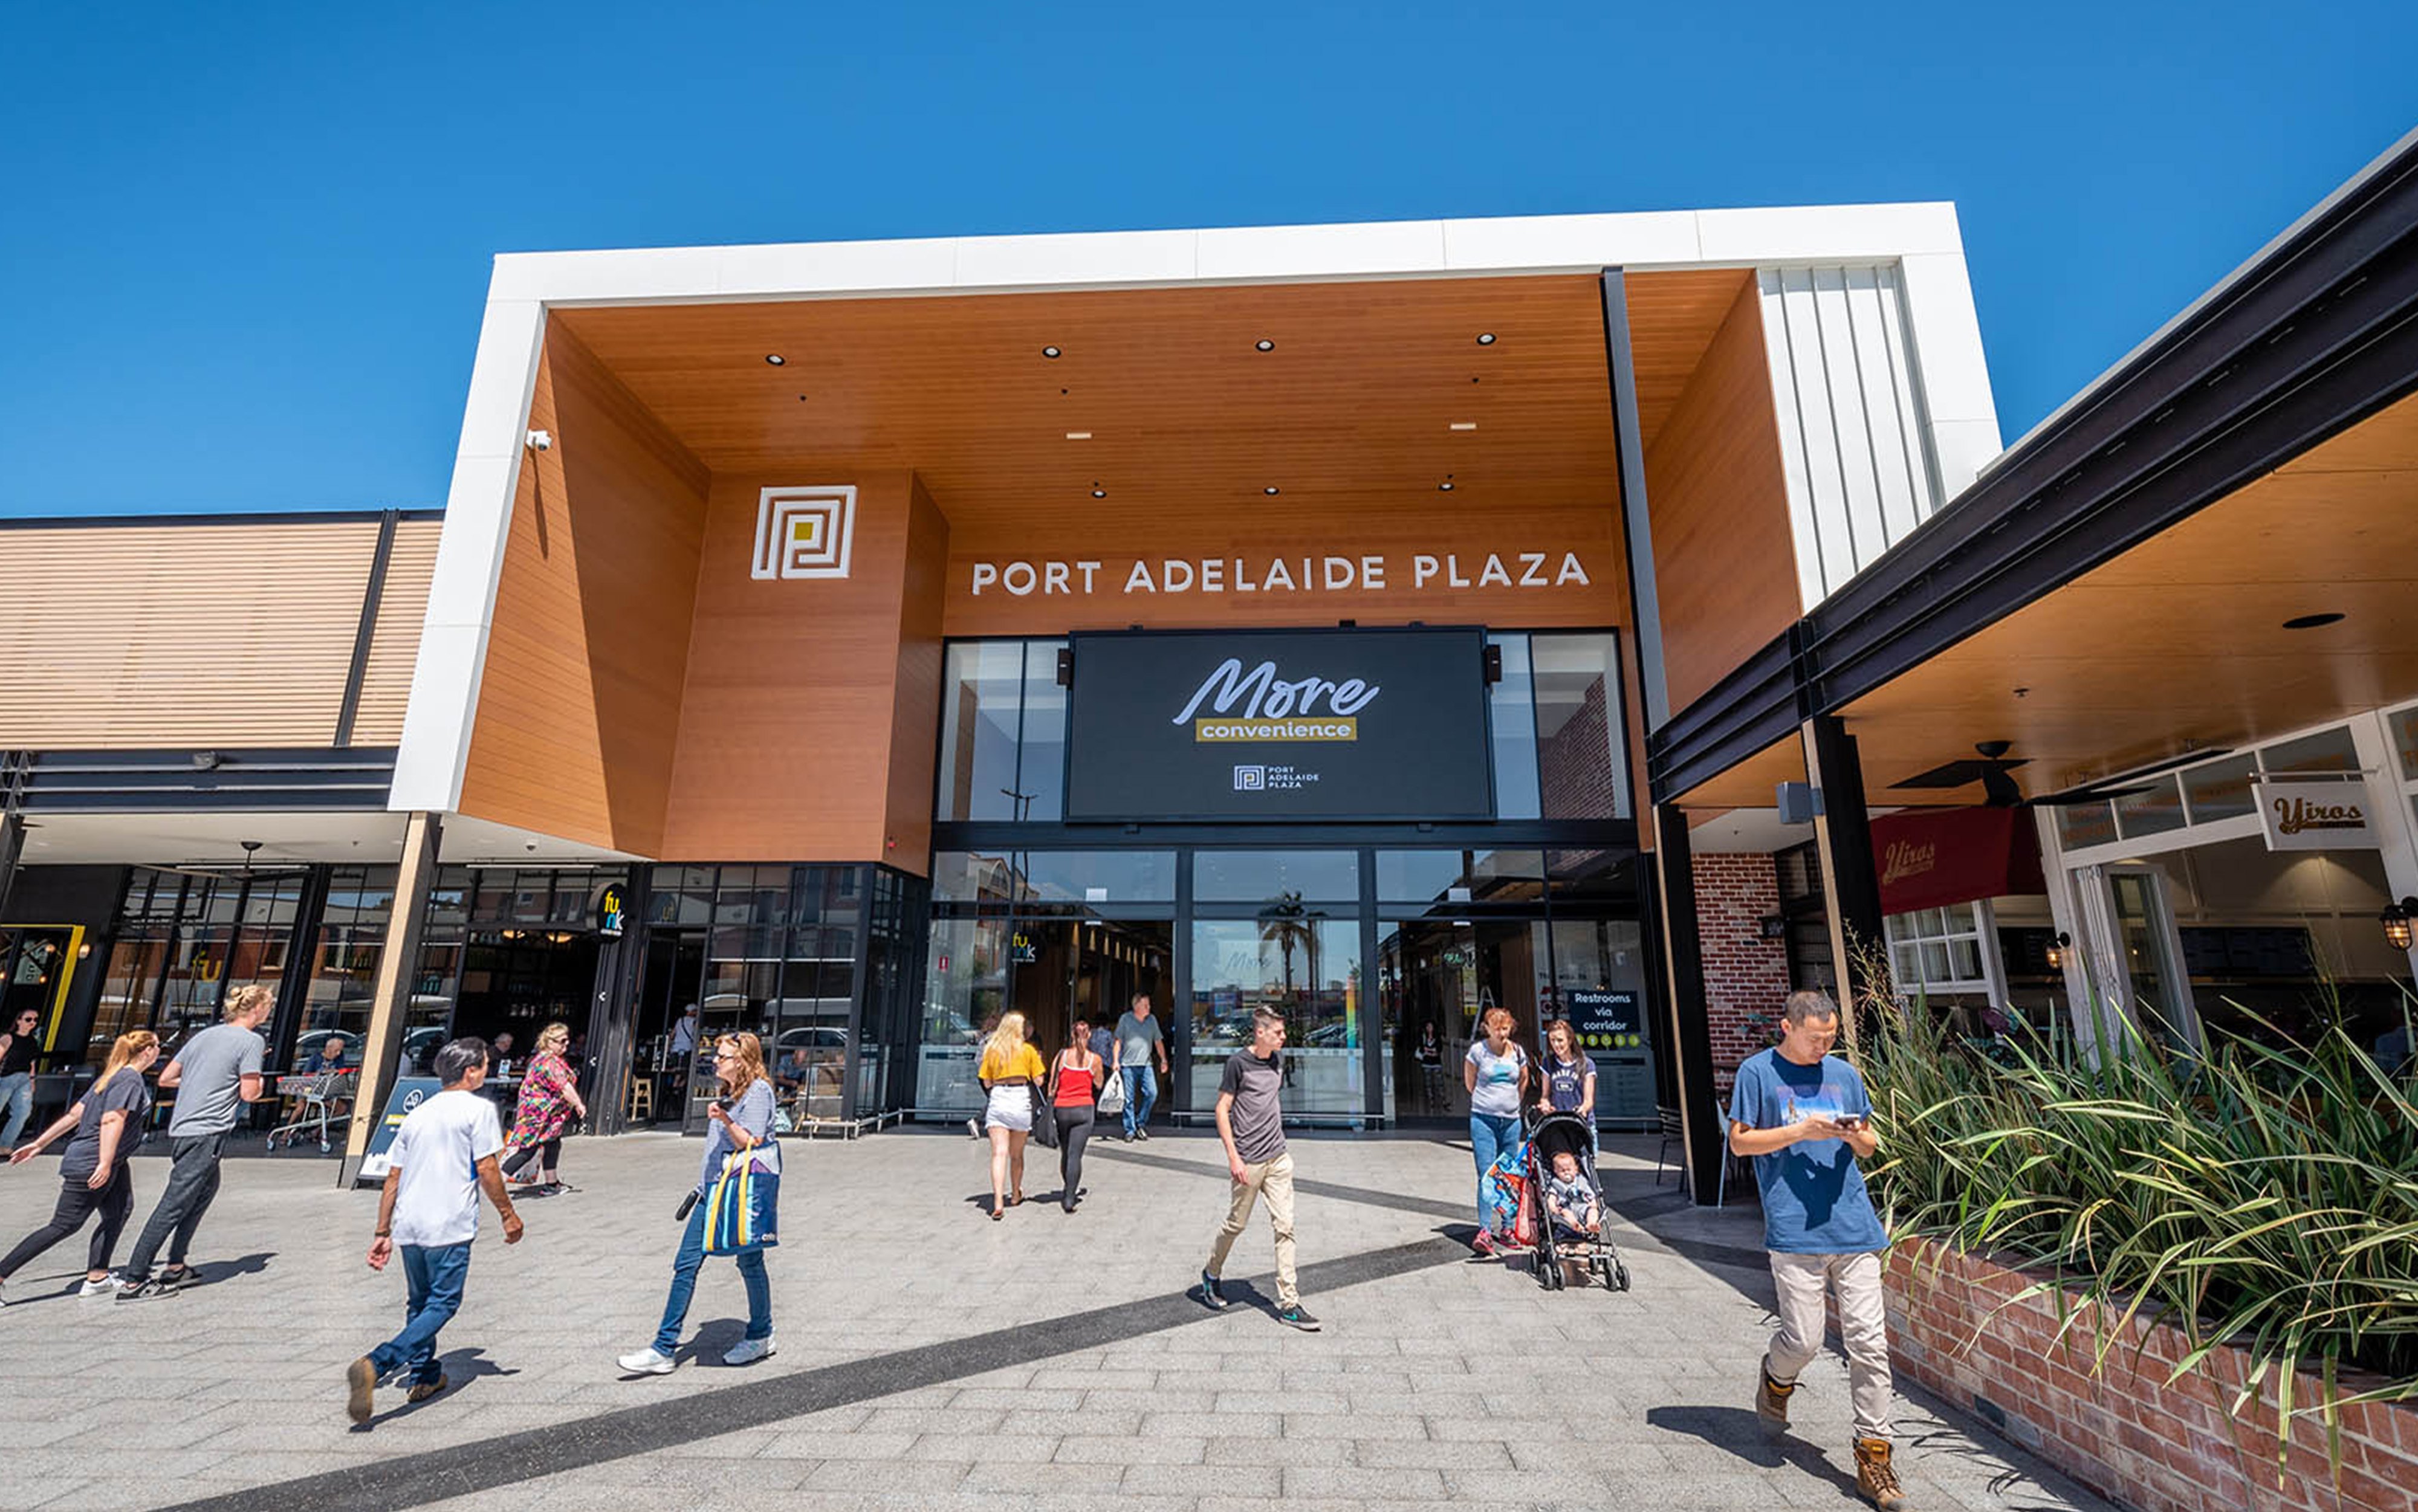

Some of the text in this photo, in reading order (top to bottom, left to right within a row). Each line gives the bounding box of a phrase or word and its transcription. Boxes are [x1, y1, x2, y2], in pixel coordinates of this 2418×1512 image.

[971, 552, 1590, 595] PORT ADELAIDE PLAZA
[1172, 658, 1381, 726] More
[1202, 722, 1352, 738] convenience
[2274, 797, 2364, 835] Yiros
[1574, 993, 1632, 1003] Restrooms
[1594, 1007, 1613, 1017] via
[1583, 1020, 1627, 1030] corridor
